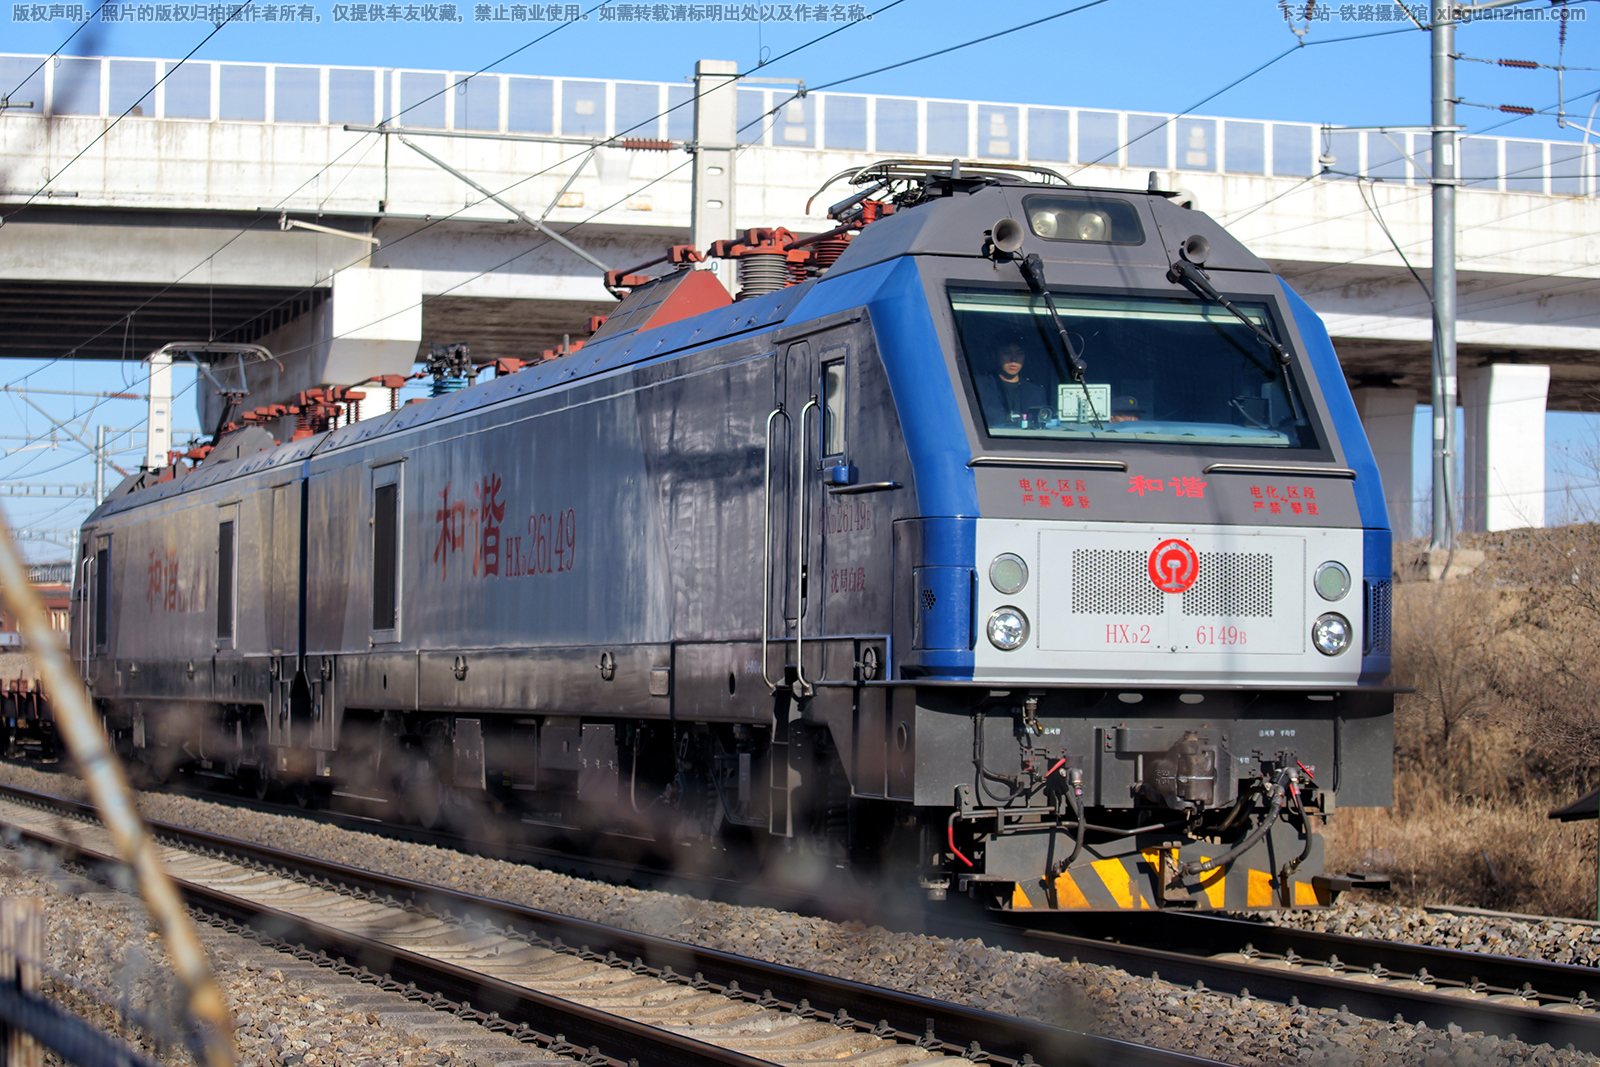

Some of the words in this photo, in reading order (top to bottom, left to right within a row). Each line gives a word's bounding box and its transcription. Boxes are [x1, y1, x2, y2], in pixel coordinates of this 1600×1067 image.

[1127, 475, 1207, 498] 和谐
[433, 471, 506, 582] 和谐
[146, 543, 180, 615] 和谐
[1105, 623, 1152, 644] HXD2
[1195, 625, 1248, 645] 6149B
